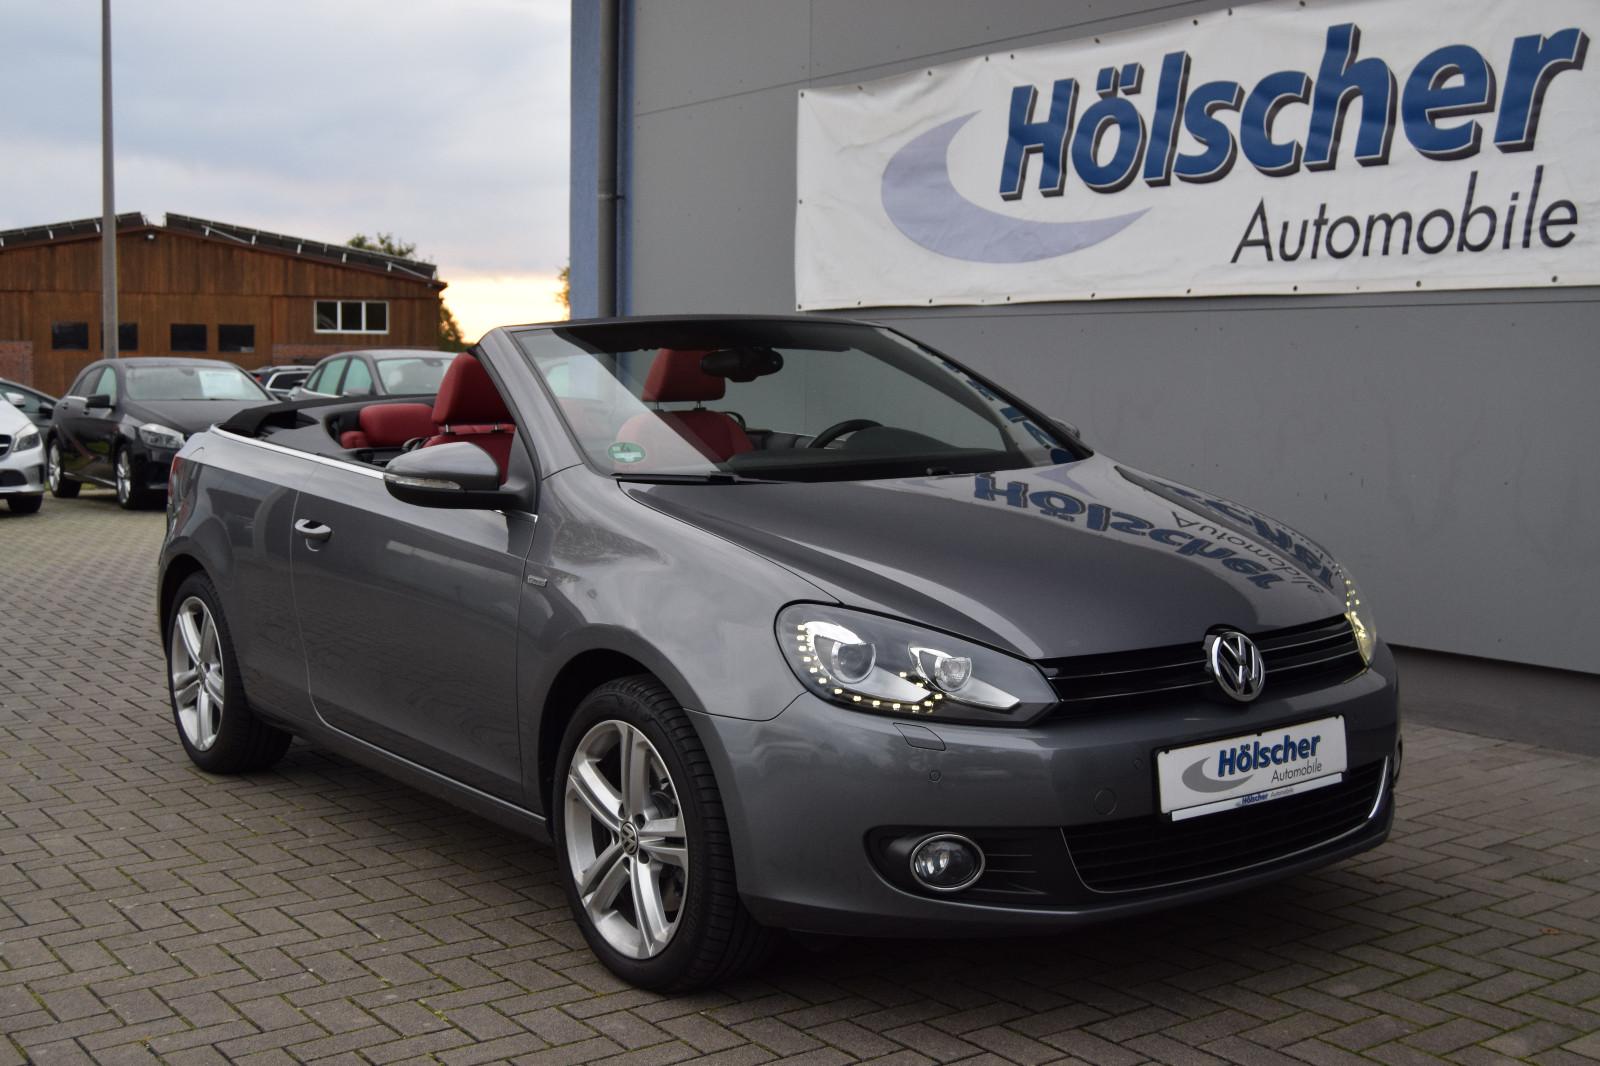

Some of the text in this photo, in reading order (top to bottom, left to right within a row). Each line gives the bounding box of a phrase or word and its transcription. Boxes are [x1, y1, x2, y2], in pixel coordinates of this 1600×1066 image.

[999, 22, 1590, 202] Hölscher
[1231, 165, 1578, 263] Automobile
[1218, 735, 1321, 777] Hölscher
[1271, 758, 1322, 783] Automobile
